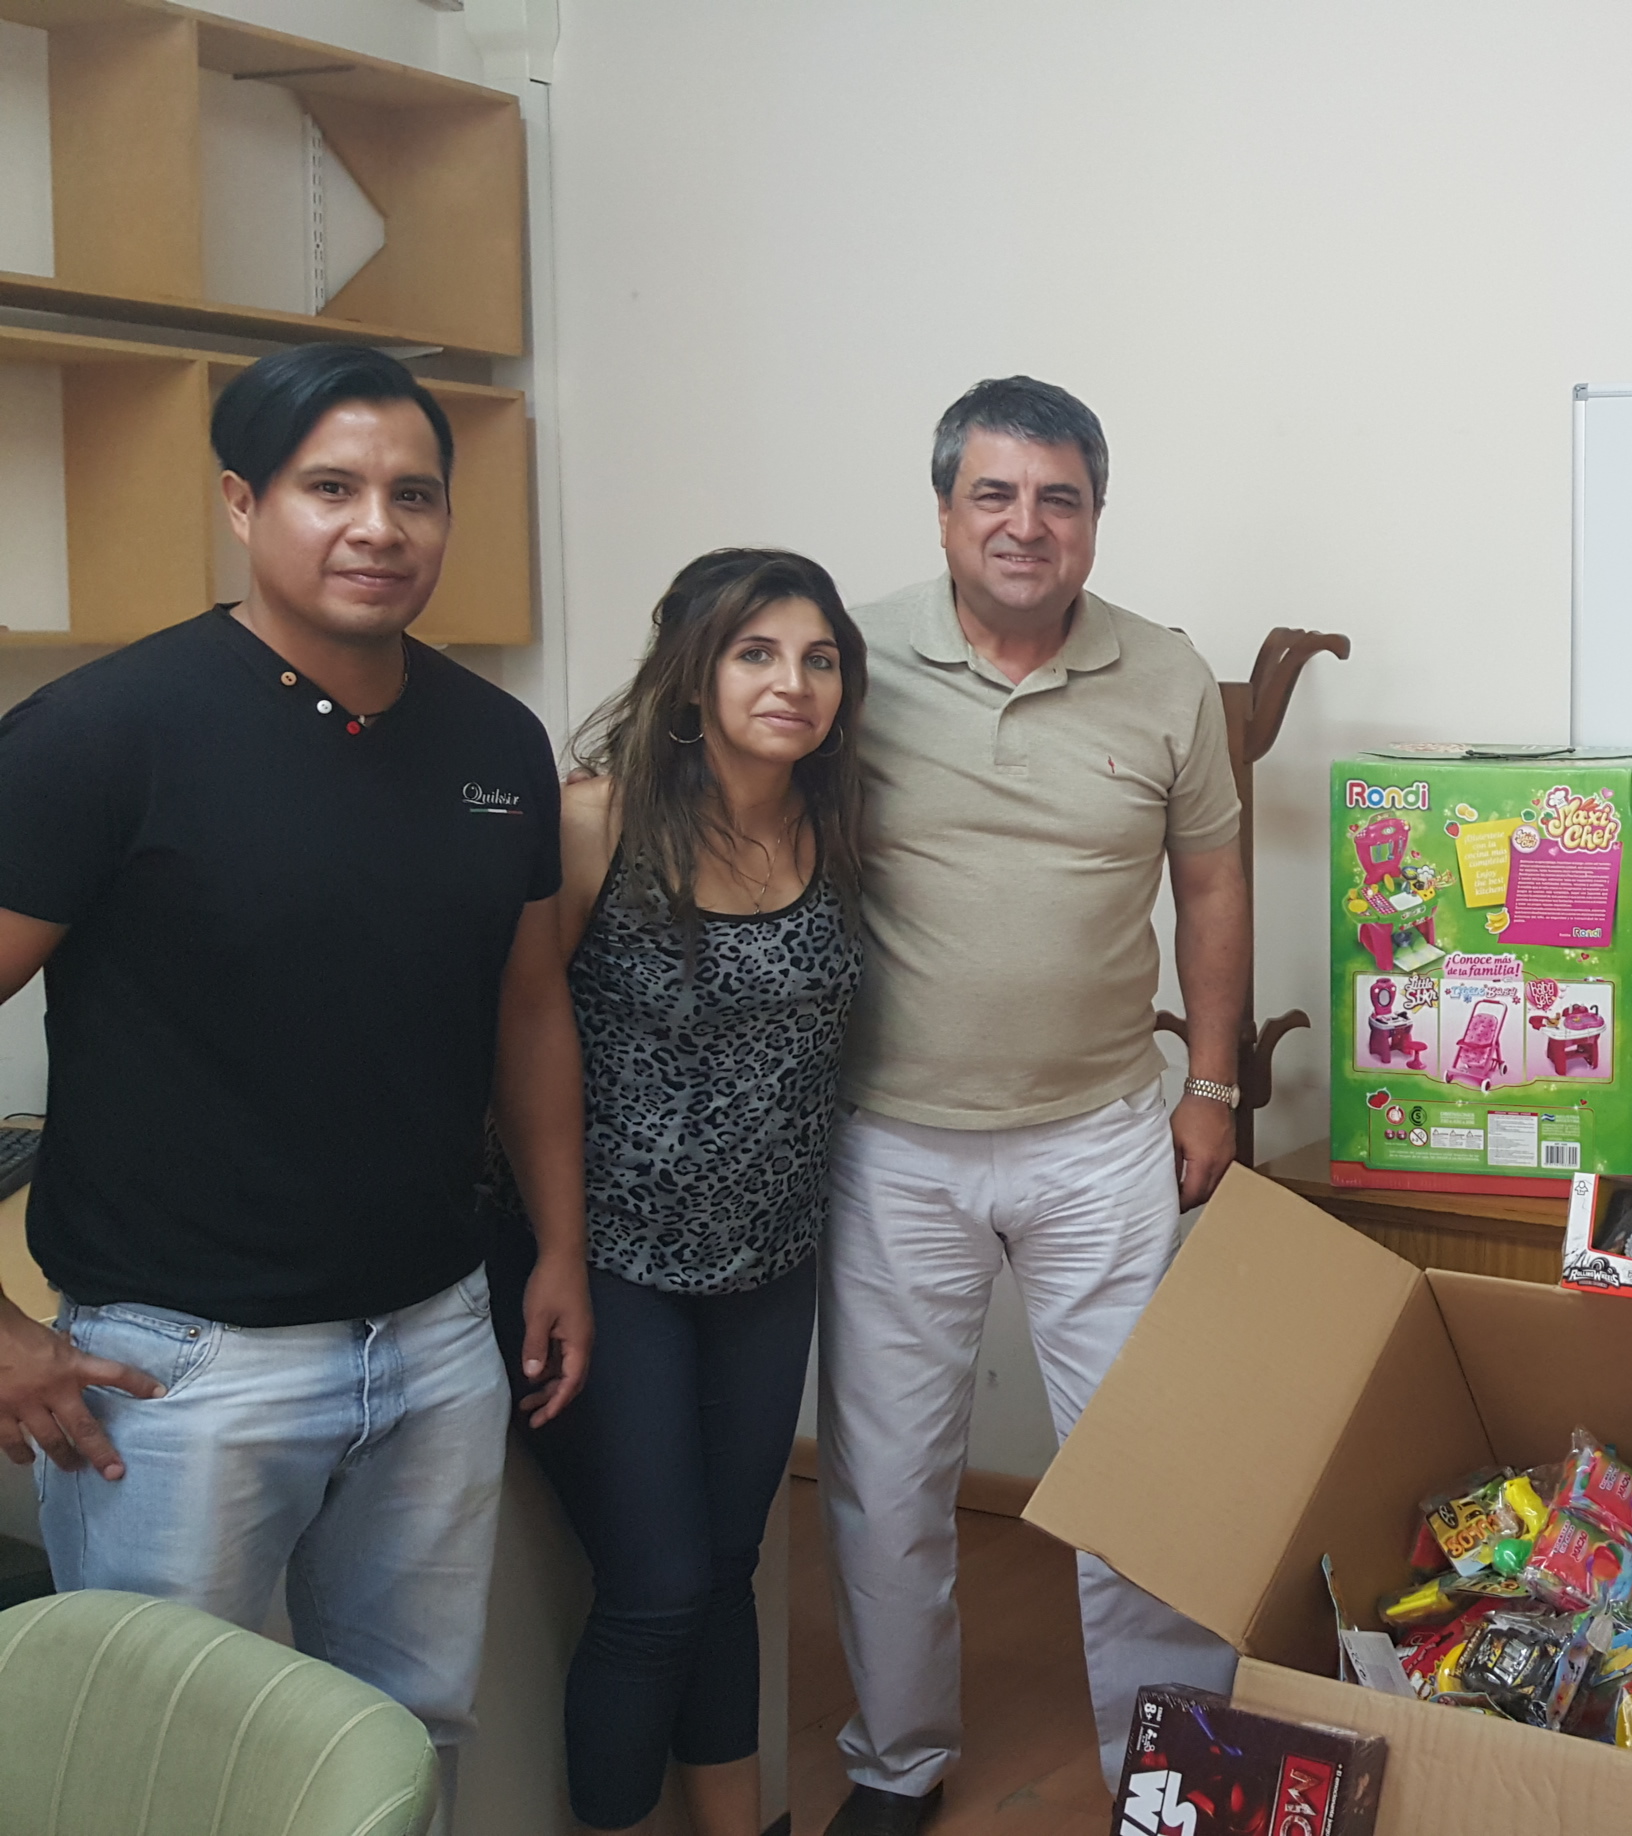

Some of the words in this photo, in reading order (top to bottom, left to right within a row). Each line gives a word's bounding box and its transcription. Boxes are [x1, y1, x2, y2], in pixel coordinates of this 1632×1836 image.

[1348, 781, 1429, 809] Rondi
[1548, 798, 1610, 836] Maxi
[1563, 822, 1617, 850] Chef
[1475, 880, 1486, 888] the
[1488, 877, 1505, 886] best
[1476, 869, 1496, 879] Enjoy
[1475, 884, 1506, 896] kitchen!
[1573, 927, 1602, 938] Rondi
[1445, 954, 1492, 969] ¡Conoce
[1494, 956, 1512, 965] más
[1447, 967, 1458, 976] de
[1459, 968, 1468, 976] la
[1468, 963, 1520, 977] familia!
[1404, 975, 1434, 990] Little
[1528, 981, 1555, 997] Baby
[1617, 1473, 1632, 1497] MACAO
[1571, 1531, 1588, 1560] MACAO
[1144, 1702, 1157, 1721] 8+
[1120, 1770, 1168, 1836] W
[1329, 1776, 1340, 1818] emocionante
